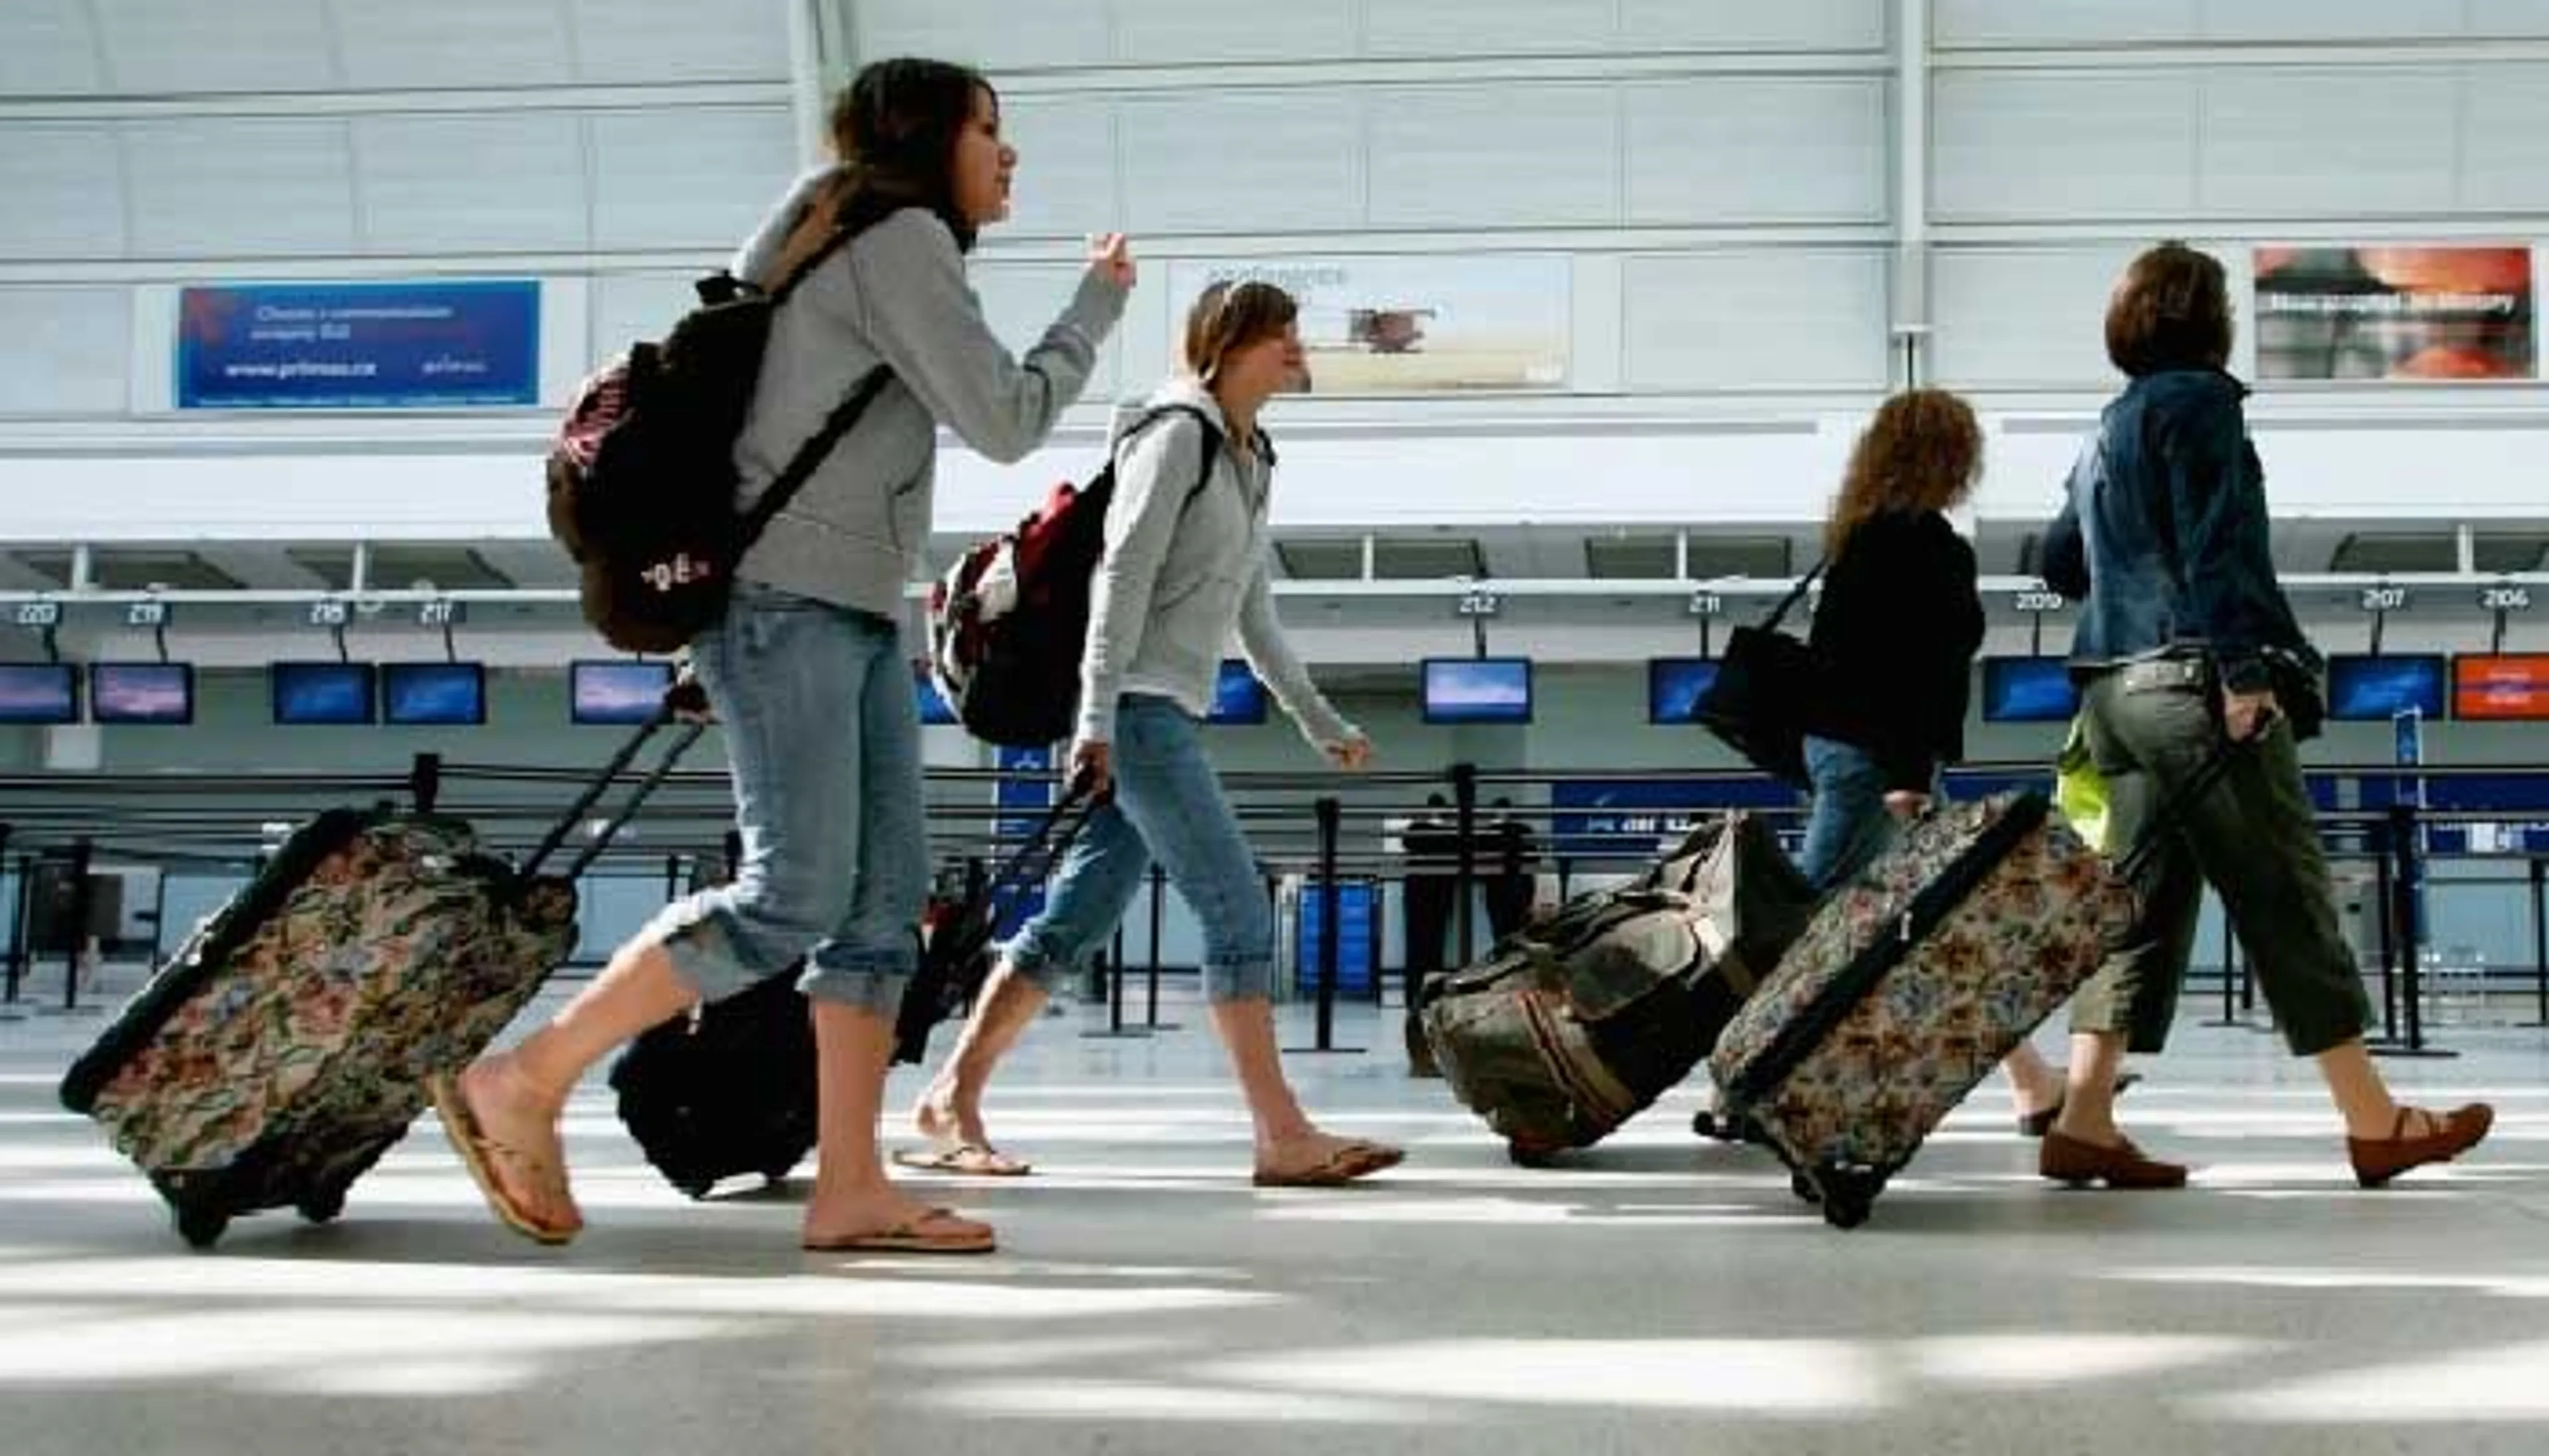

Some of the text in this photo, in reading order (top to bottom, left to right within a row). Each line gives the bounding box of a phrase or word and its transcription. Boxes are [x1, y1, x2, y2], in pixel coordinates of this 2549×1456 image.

[1460, 597, 1495, 613] 212
[1689, 597, 1720, 613] 211
[2363, 589, 2404, 610] 207
